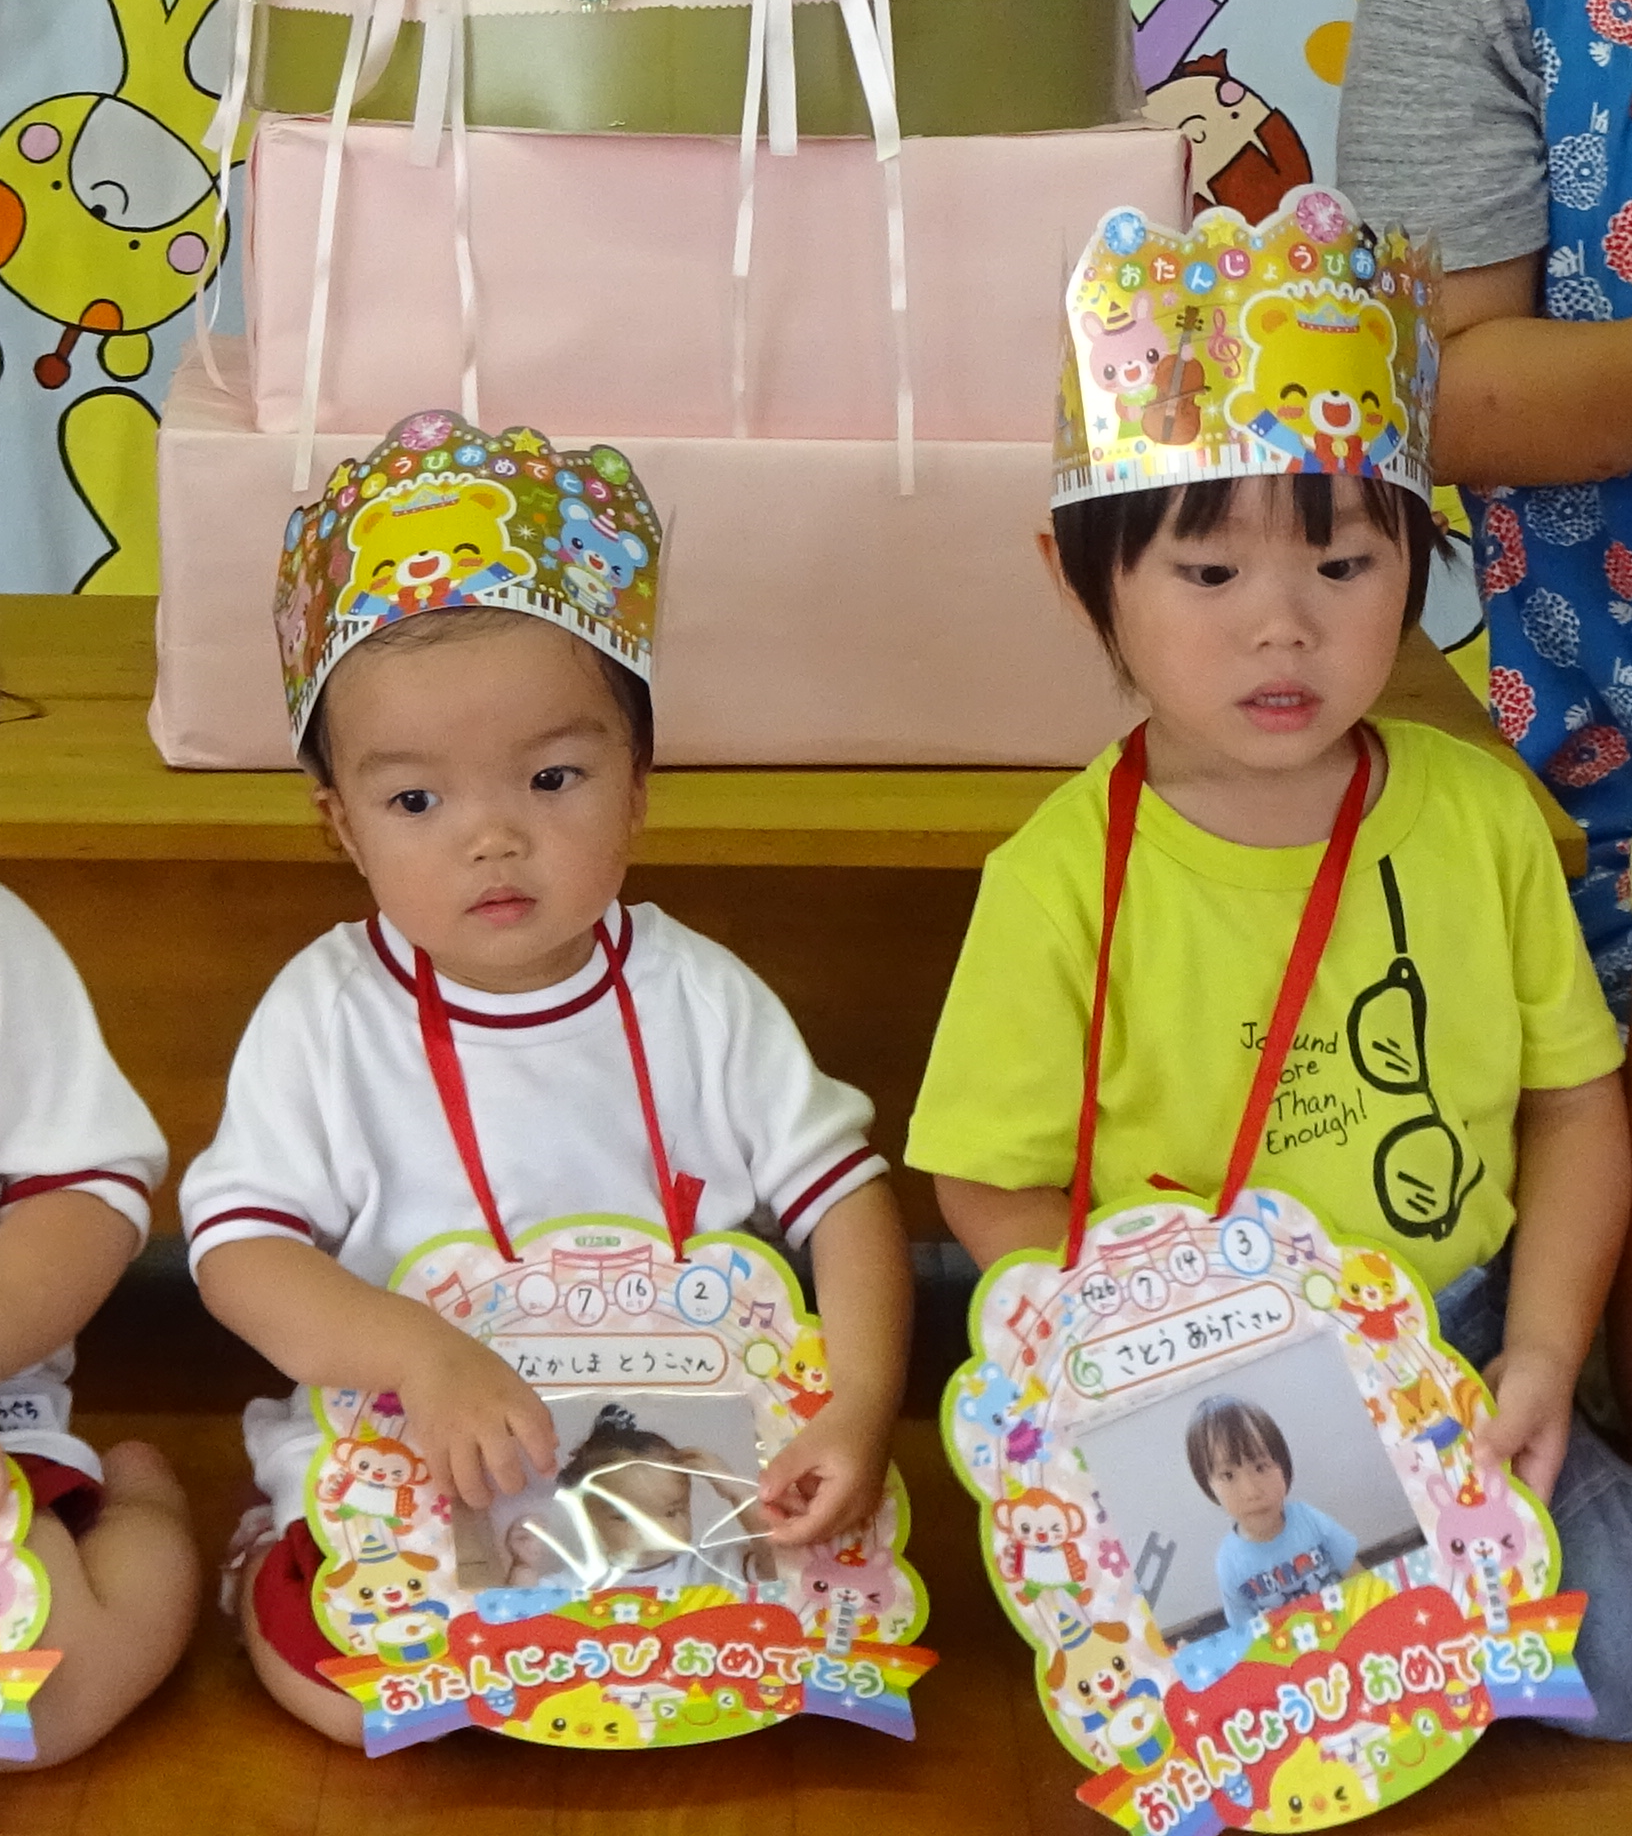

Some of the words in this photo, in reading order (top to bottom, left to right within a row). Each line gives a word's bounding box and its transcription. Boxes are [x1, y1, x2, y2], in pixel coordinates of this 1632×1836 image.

[1269, 1089, 1337, 1122] Than
[1266, 1087, 1367, 1155] Enough!
[1235, 1228, 1253, 1256] 3
[577, 1287, 593, 1313] 7
[626, 1278, 647, 1297] 16
[694, 1281, 710, 1300] 2
[1137, 1277, 1153, 1298] 7
[517, 1353, 601, 1377] なかしま
[1117, 1328, 1176, 1376] さとう
[379, 1636, 663, 1715] おたんじょうび
[671, 1638, 885, 1698] おめでとう
[1134, 1663, 1351, 1835] おたんじょうび
[1359, 1630, 1554, 1704] おめでとう
